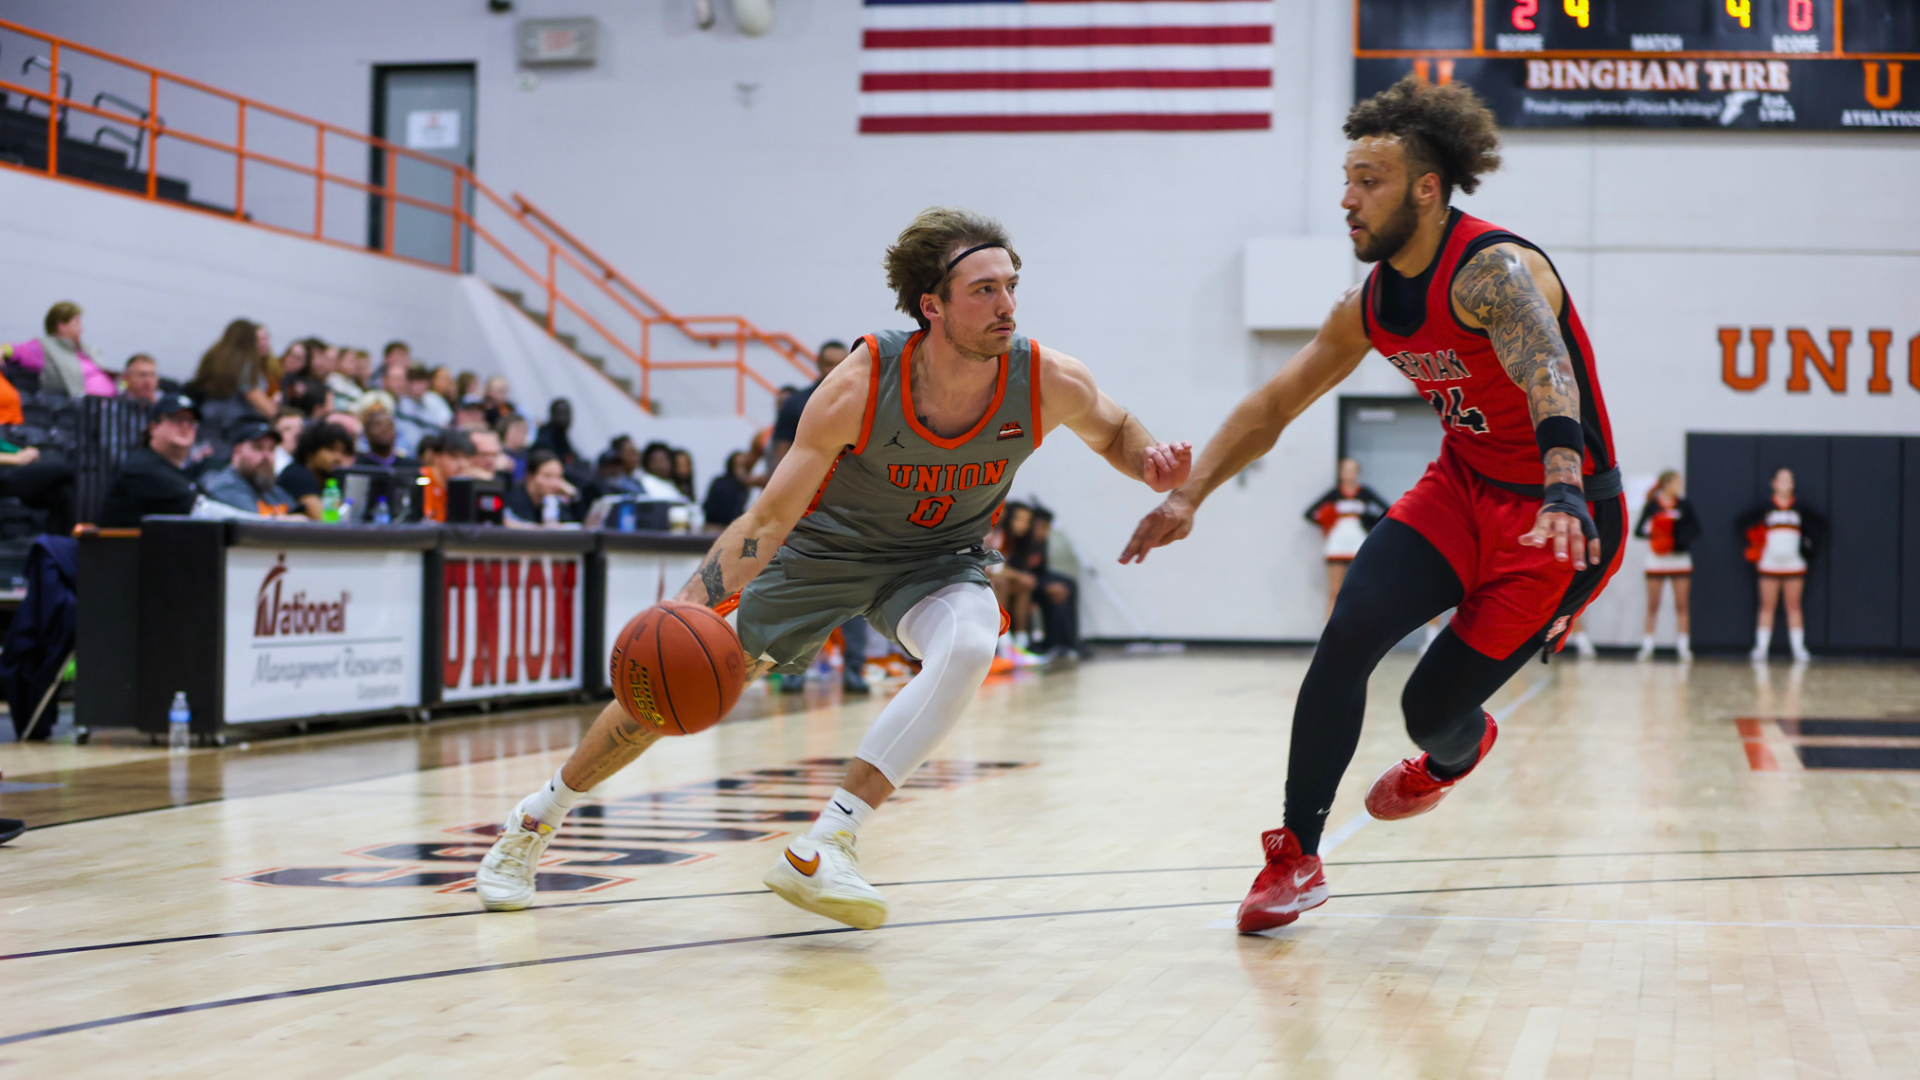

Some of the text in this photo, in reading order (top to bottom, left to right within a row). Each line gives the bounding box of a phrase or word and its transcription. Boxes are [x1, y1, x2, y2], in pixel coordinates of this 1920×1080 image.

[1563, 0, 1590, 29] 4
[1726, 0, 1751, 29] 4
[1631, 34, 1683, 51] MATCH
[1772, 35, 1820, 53] SCORE
[1526, 59, 1790, 92] BINGHAM TIRE
[1863, 61, 1904, 110] U
[1717, 327, 1920, 394] UNI
[1001, 421, 1020, 431] AAC
[888, 458, 1009, 493] UNION
[907, 494, 957, 530] 0
[254, 566, 350, 637] National
[443, 559, 577, 688] UNION
[629, 658, 659, 728] EGACY
